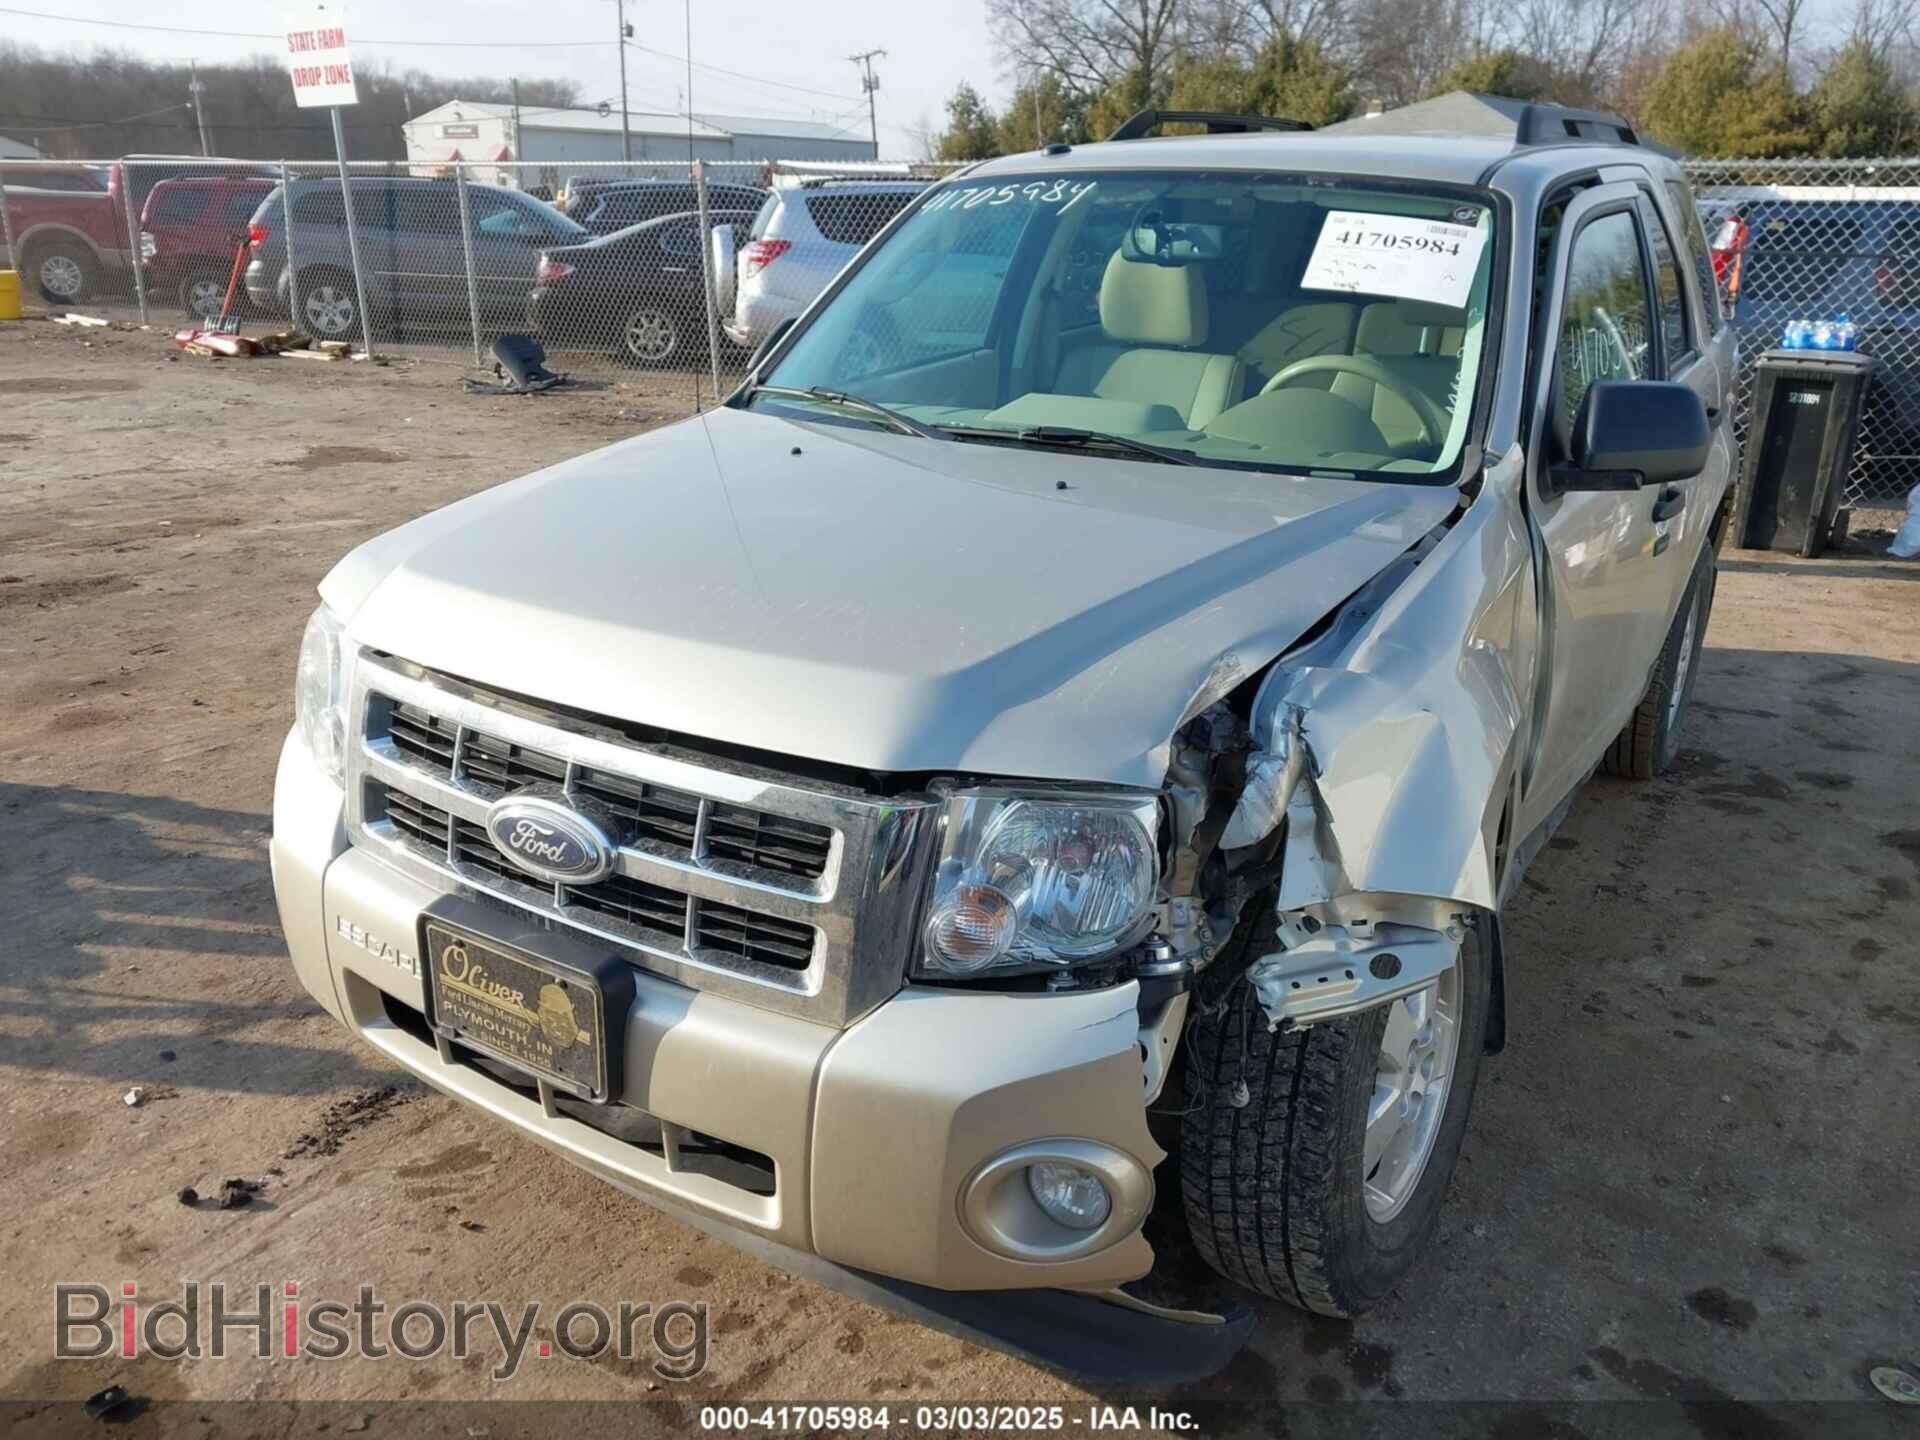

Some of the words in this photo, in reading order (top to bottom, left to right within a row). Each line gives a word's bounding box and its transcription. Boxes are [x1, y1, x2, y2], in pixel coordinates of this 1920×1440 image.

[287, 31, 317, 53] STATE
[318, 27, 345, 50] FARM
[293, 66, 321, 88] DROP
[323, 64, 351, 86] ZONE
[1335, 230, 1461, 257] 41705984
[510, 820, 567, 862] Ford
